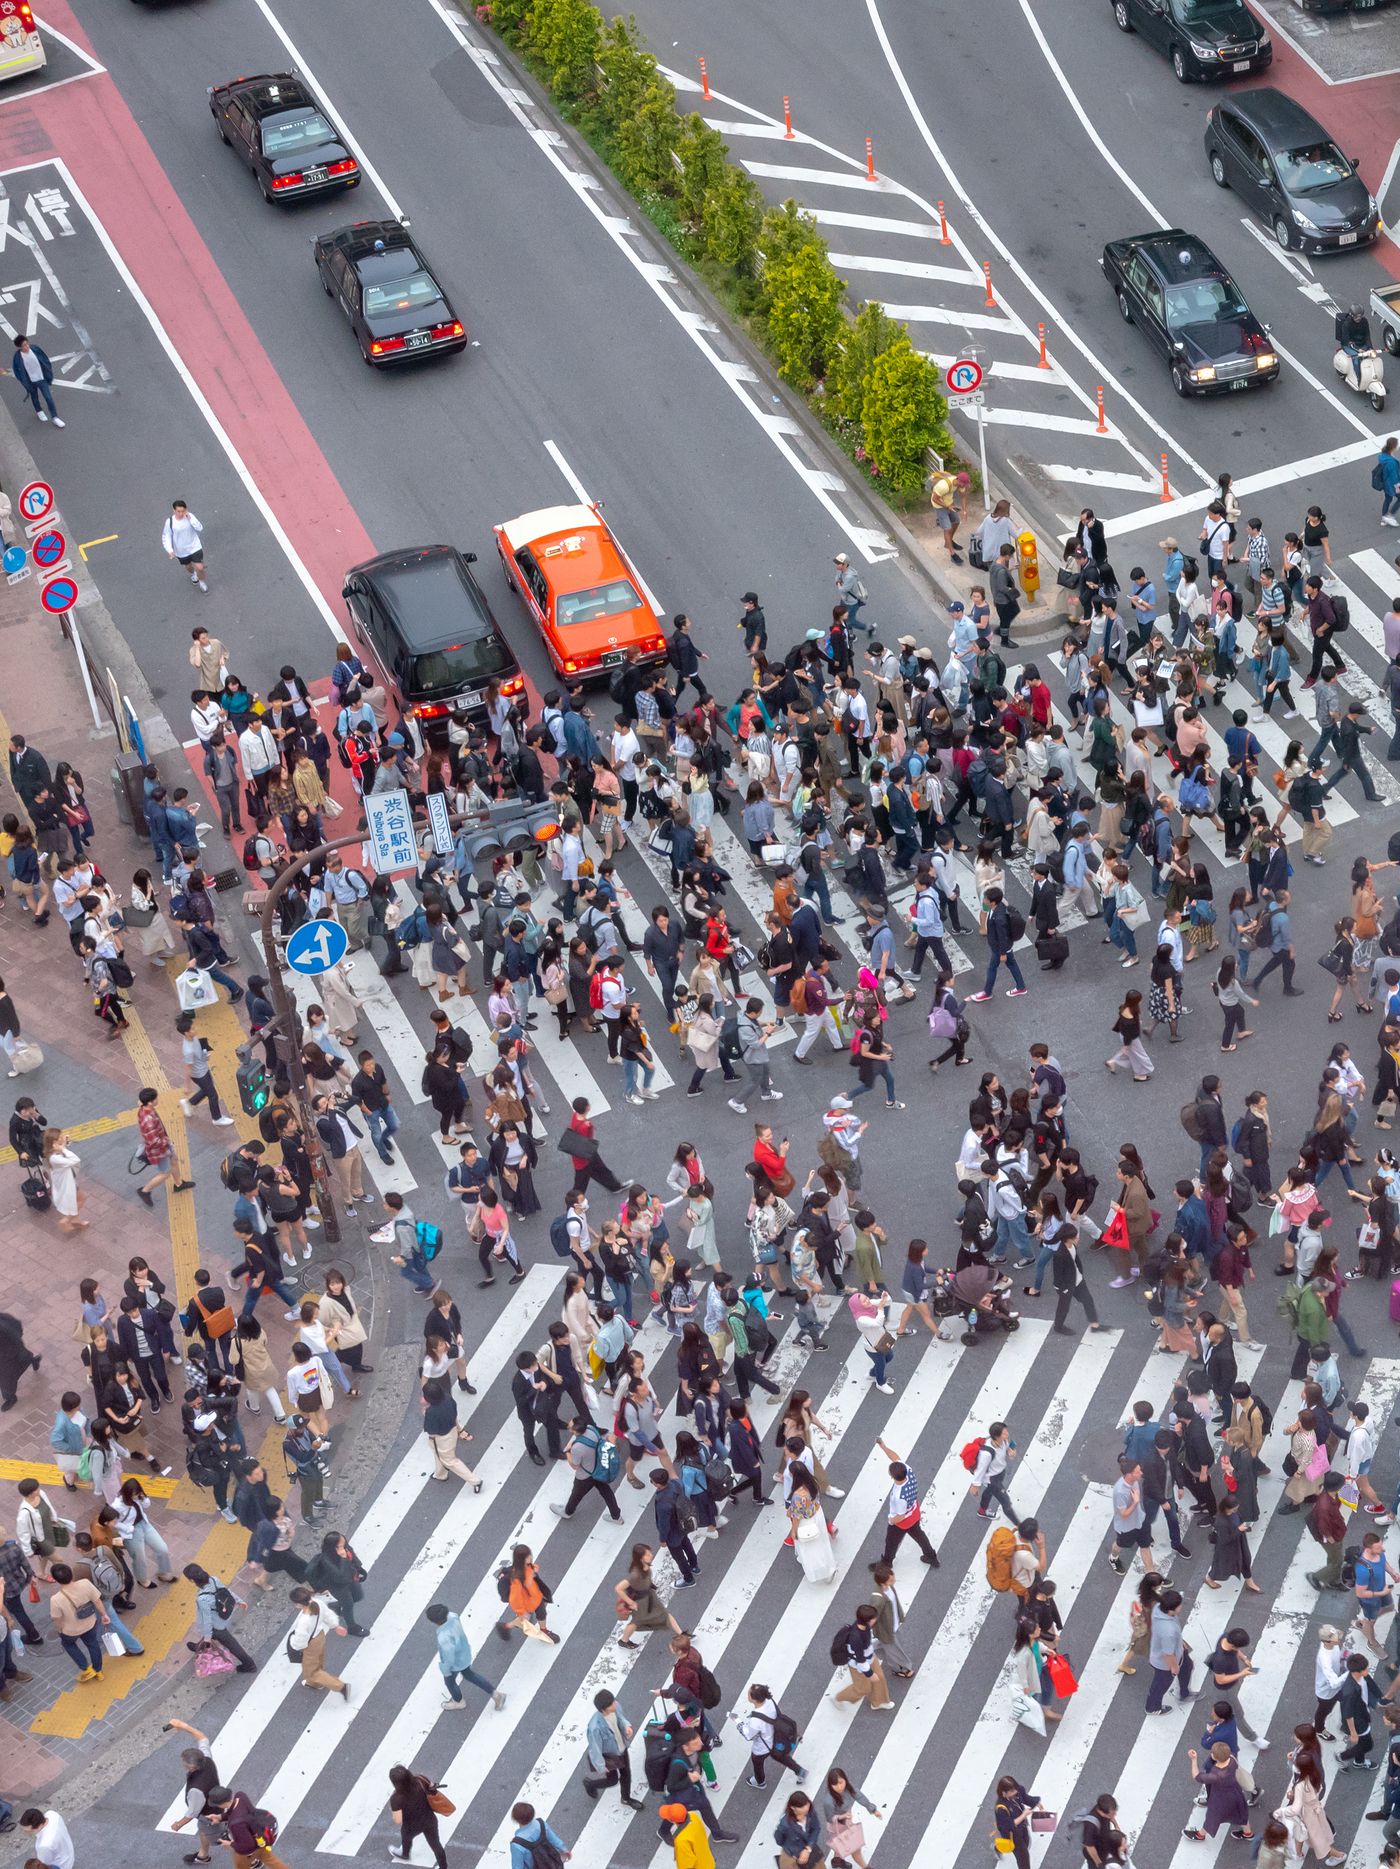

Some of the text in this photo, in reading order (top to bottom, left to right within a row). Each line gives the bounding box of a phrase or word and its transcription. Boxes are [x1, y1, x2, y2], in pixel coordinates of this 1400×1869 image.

[950, 395, 982, 407] ここまで
[373, 811, 386, 842] Shibuya
[384, 797, 412, 864] 渋谷駅前
[431, 798, 450, 850] スクランブル式
